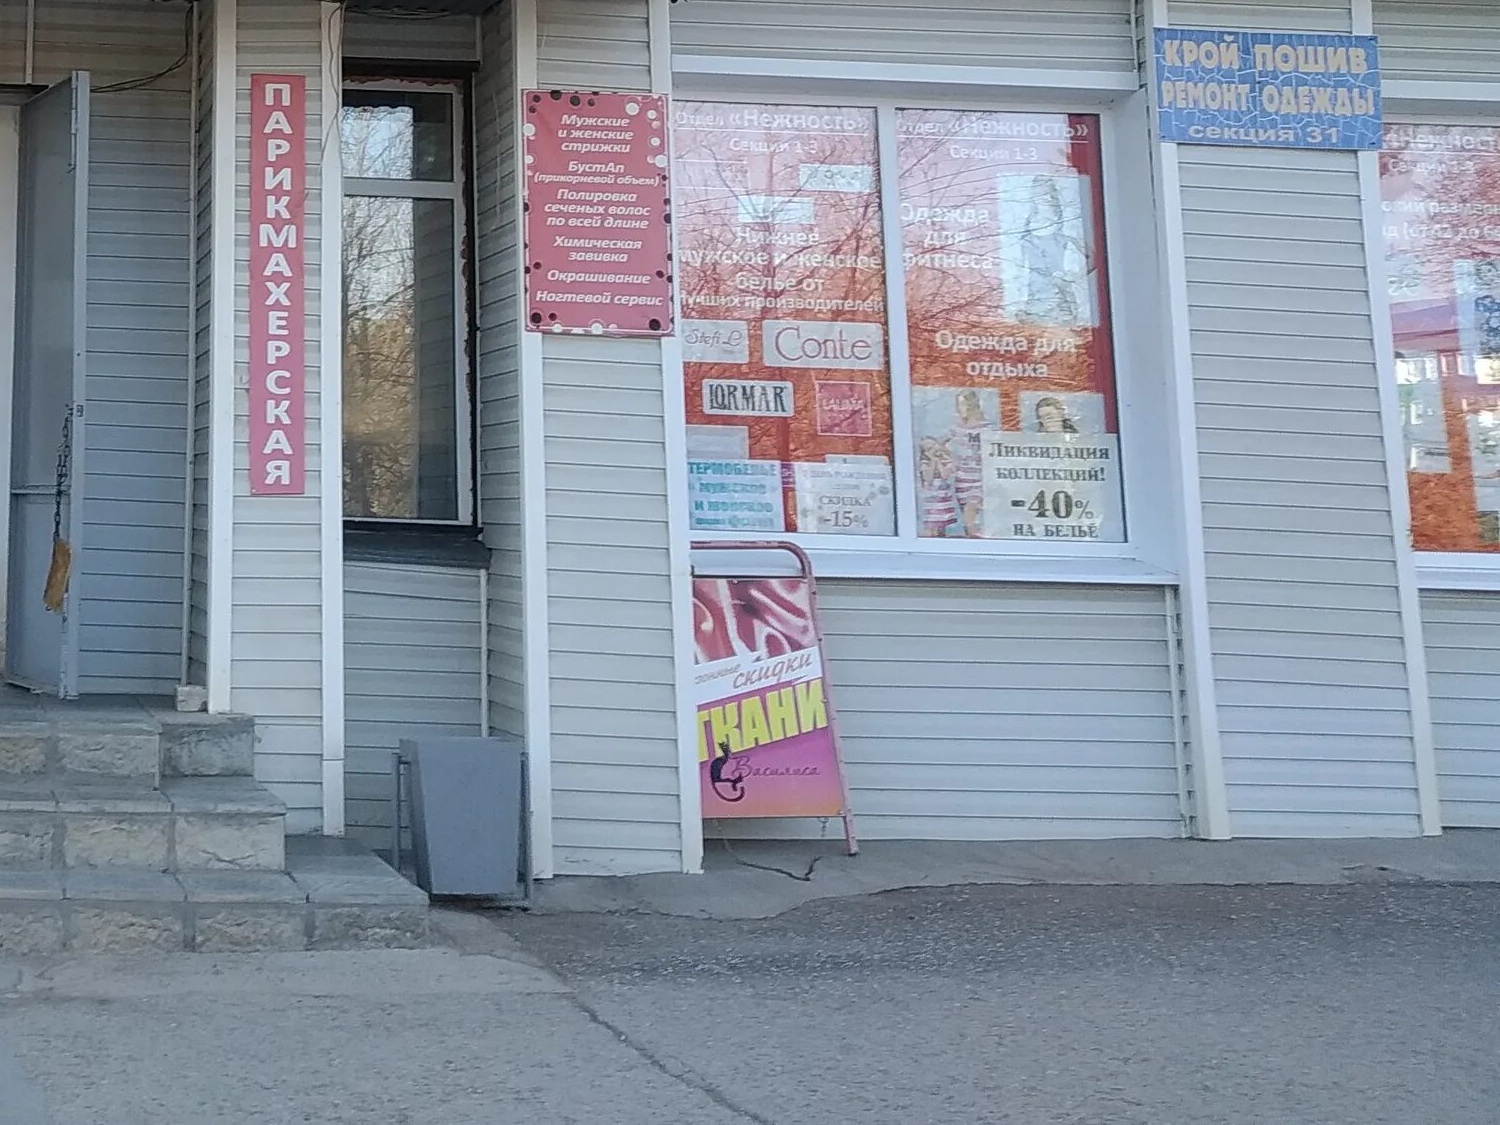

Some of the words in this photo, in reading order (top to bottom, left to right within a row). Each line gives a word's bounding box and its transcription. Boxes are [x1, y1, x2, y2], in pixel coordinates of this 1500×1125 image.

[1164, 34, 1240, 70] КРОЙ
[1255, 43, 1368, 74] ПОШИВ
[1161, 80, 1249, 111] РЕМОНТ
[1261, 84, 1375, 116] ОДЕЖДЫ
[560, 114, 630, 128] Мужские
[557, 130, 568, 139] и
[570, 129, 634, 141] женские
[1306, 127, 1340, 144] 31
[560, 142, 631, 154] стрижки
[1013, 147, 1038, 161] 1-3
[568, 161, 625, 176] БустАп
[533, 173, 615, 186] (прикорневой
[616, 174, 660, 187] объем)
[557, 188, 637, 204] Полировка
[544, 203, 606, 215] сеченых
[608, 205, 651, 216] волос
[546, 217, 568, 228] по
[570, 215, 602, 228] всей
[603, 217, 650, 230] длине
[553, 235, 643, 251] Химическая
[735, 229, 820, 246] Нижнее
[568, 251, 629, 263] завивка
[258, 82, 298, 486] ПАРИКМАХЕРСКАЯ
[547, 269, 652, 285] Окрашивание
[802, 278, 825, 292] от
[535, 289, 612, 305] Ногтевой
[614, 294, 664, 307] сервис
[685, 329, 721, 351] Stefi
[775, 326, 872, 362] Conte
[935, 330, 1028, 353] Одежда
[1032, 337, 1077, 356] для
[966, 361, 1049, 378] отдыха
[708, 382, 788, 413] LORMAR
[1010, 490, 1095, 520] -40%
[733, 654, 812, 689] скидки
